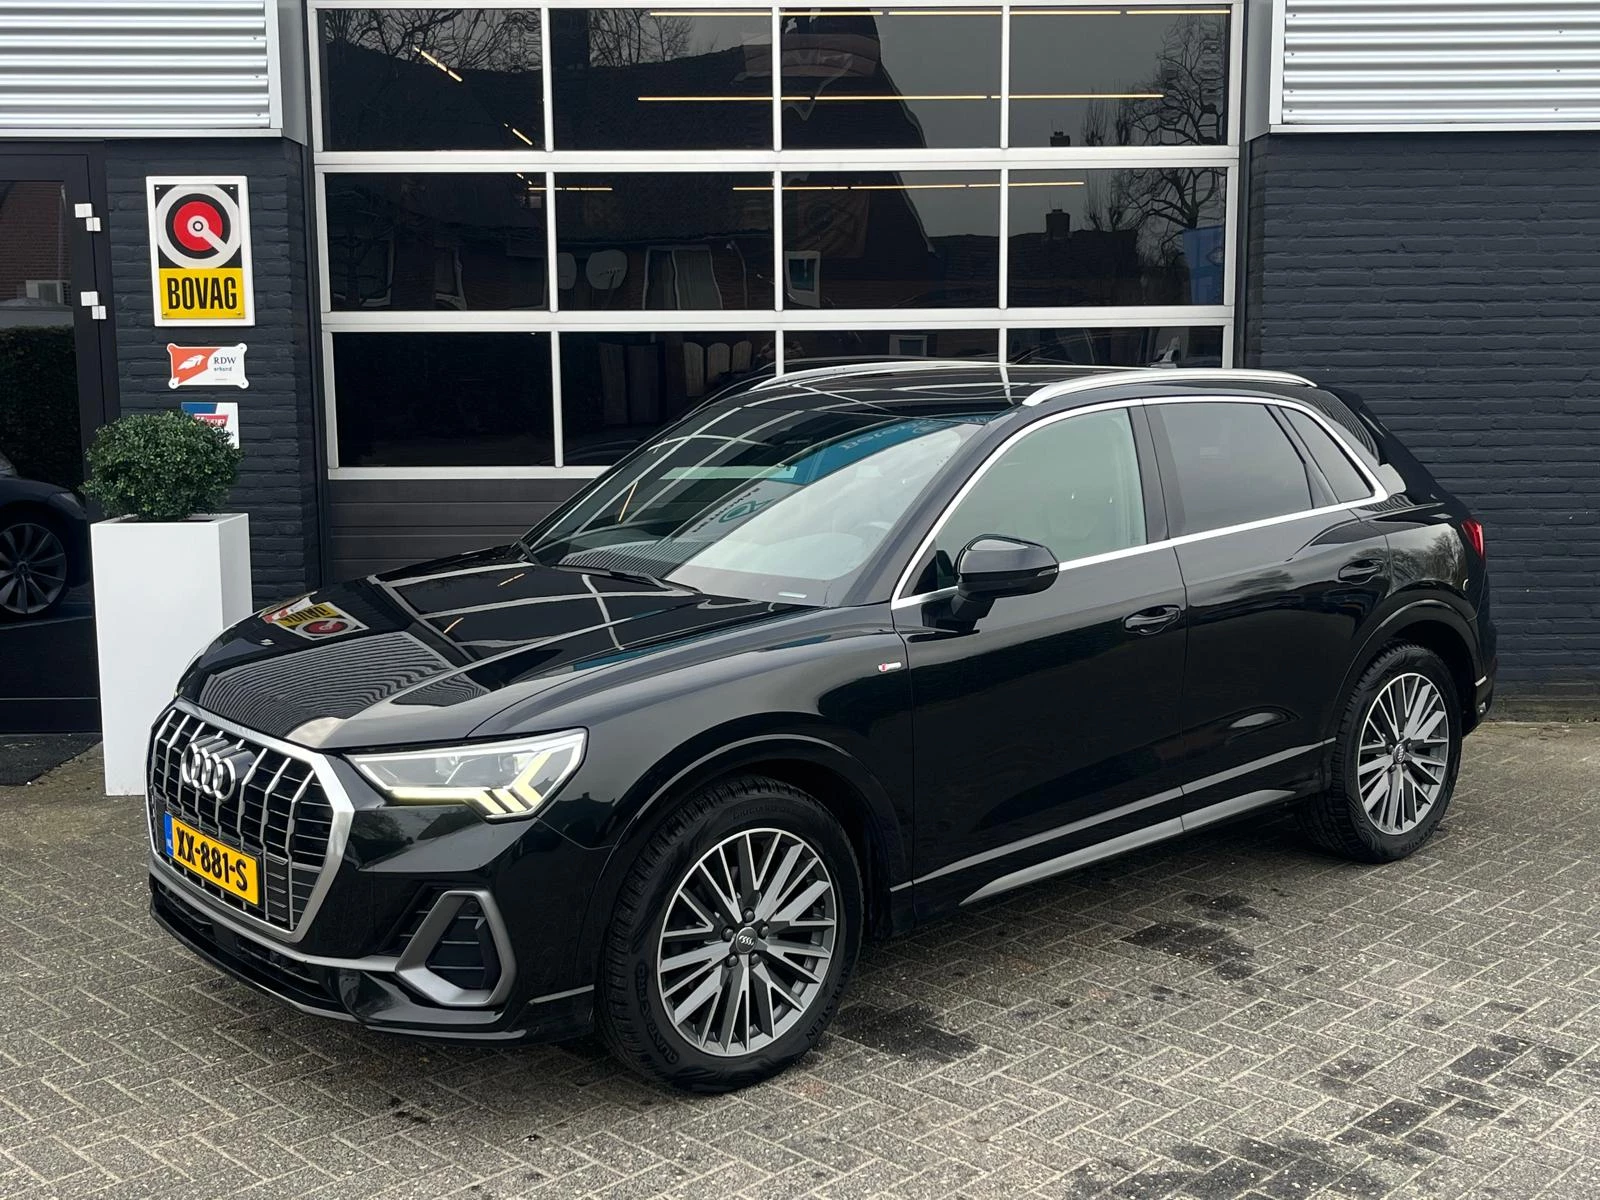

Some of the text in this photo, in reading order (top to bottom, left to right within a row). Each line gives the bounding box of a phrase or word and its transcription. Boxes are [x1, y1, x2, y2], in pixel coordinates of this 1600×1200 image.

[167, 277, 237, 310] BOVAG
[214, 356, 236, 365] RDW
[176, 826, 248, 892] XX-881-S
